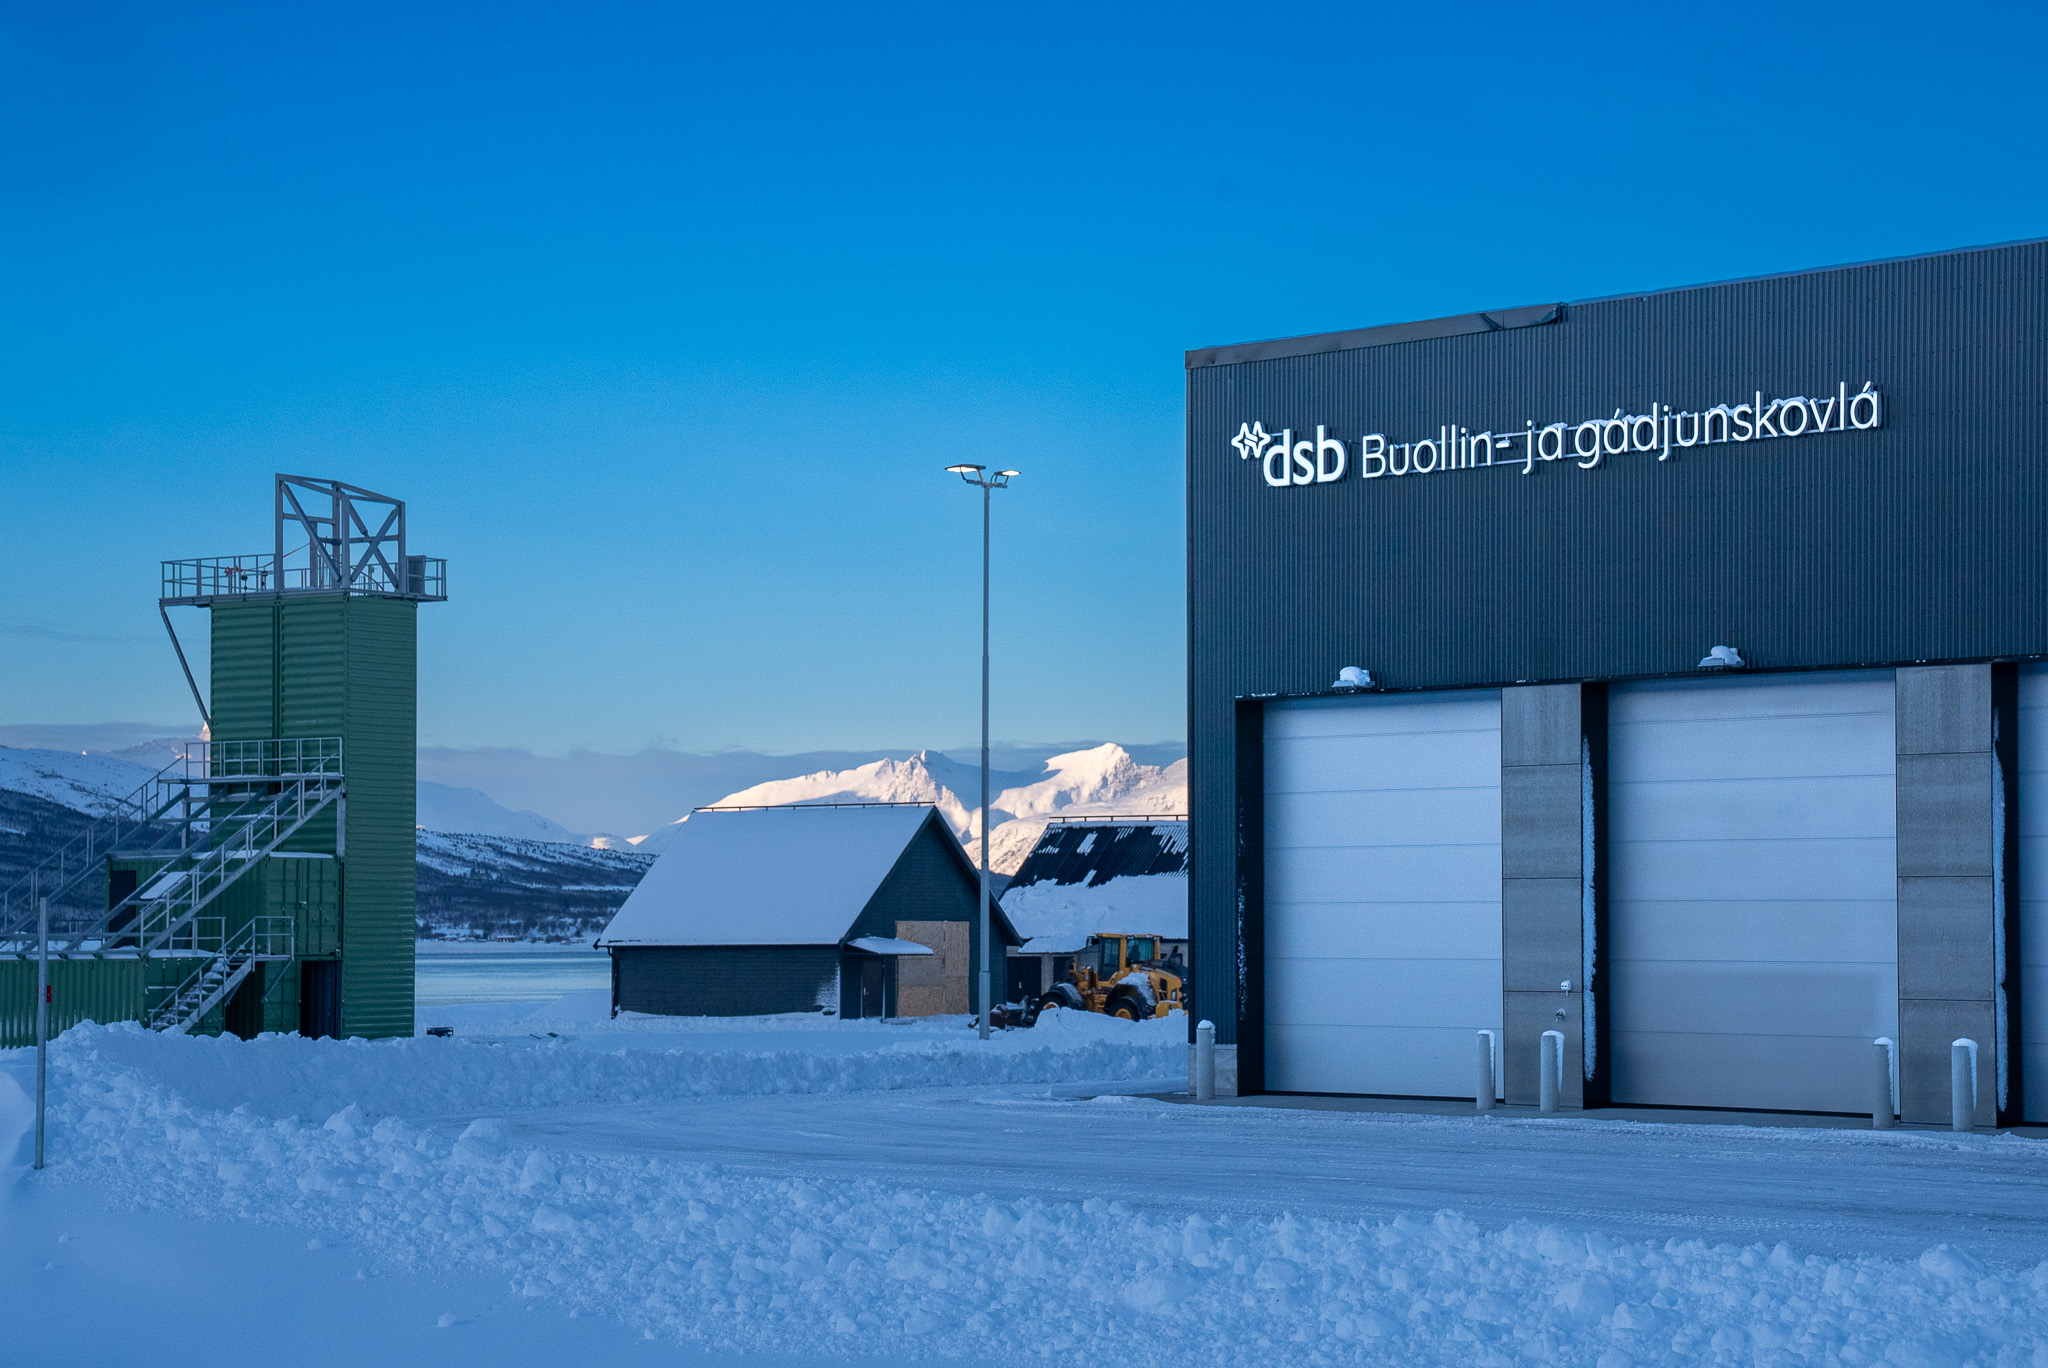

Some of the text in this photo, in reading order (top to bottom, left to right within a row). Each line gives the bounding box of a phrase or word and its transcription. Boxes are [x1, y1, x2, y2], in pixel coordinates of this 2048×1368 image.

[1263, 381, 1879, 486] dsb Buollin- ja gádjunskovlá
